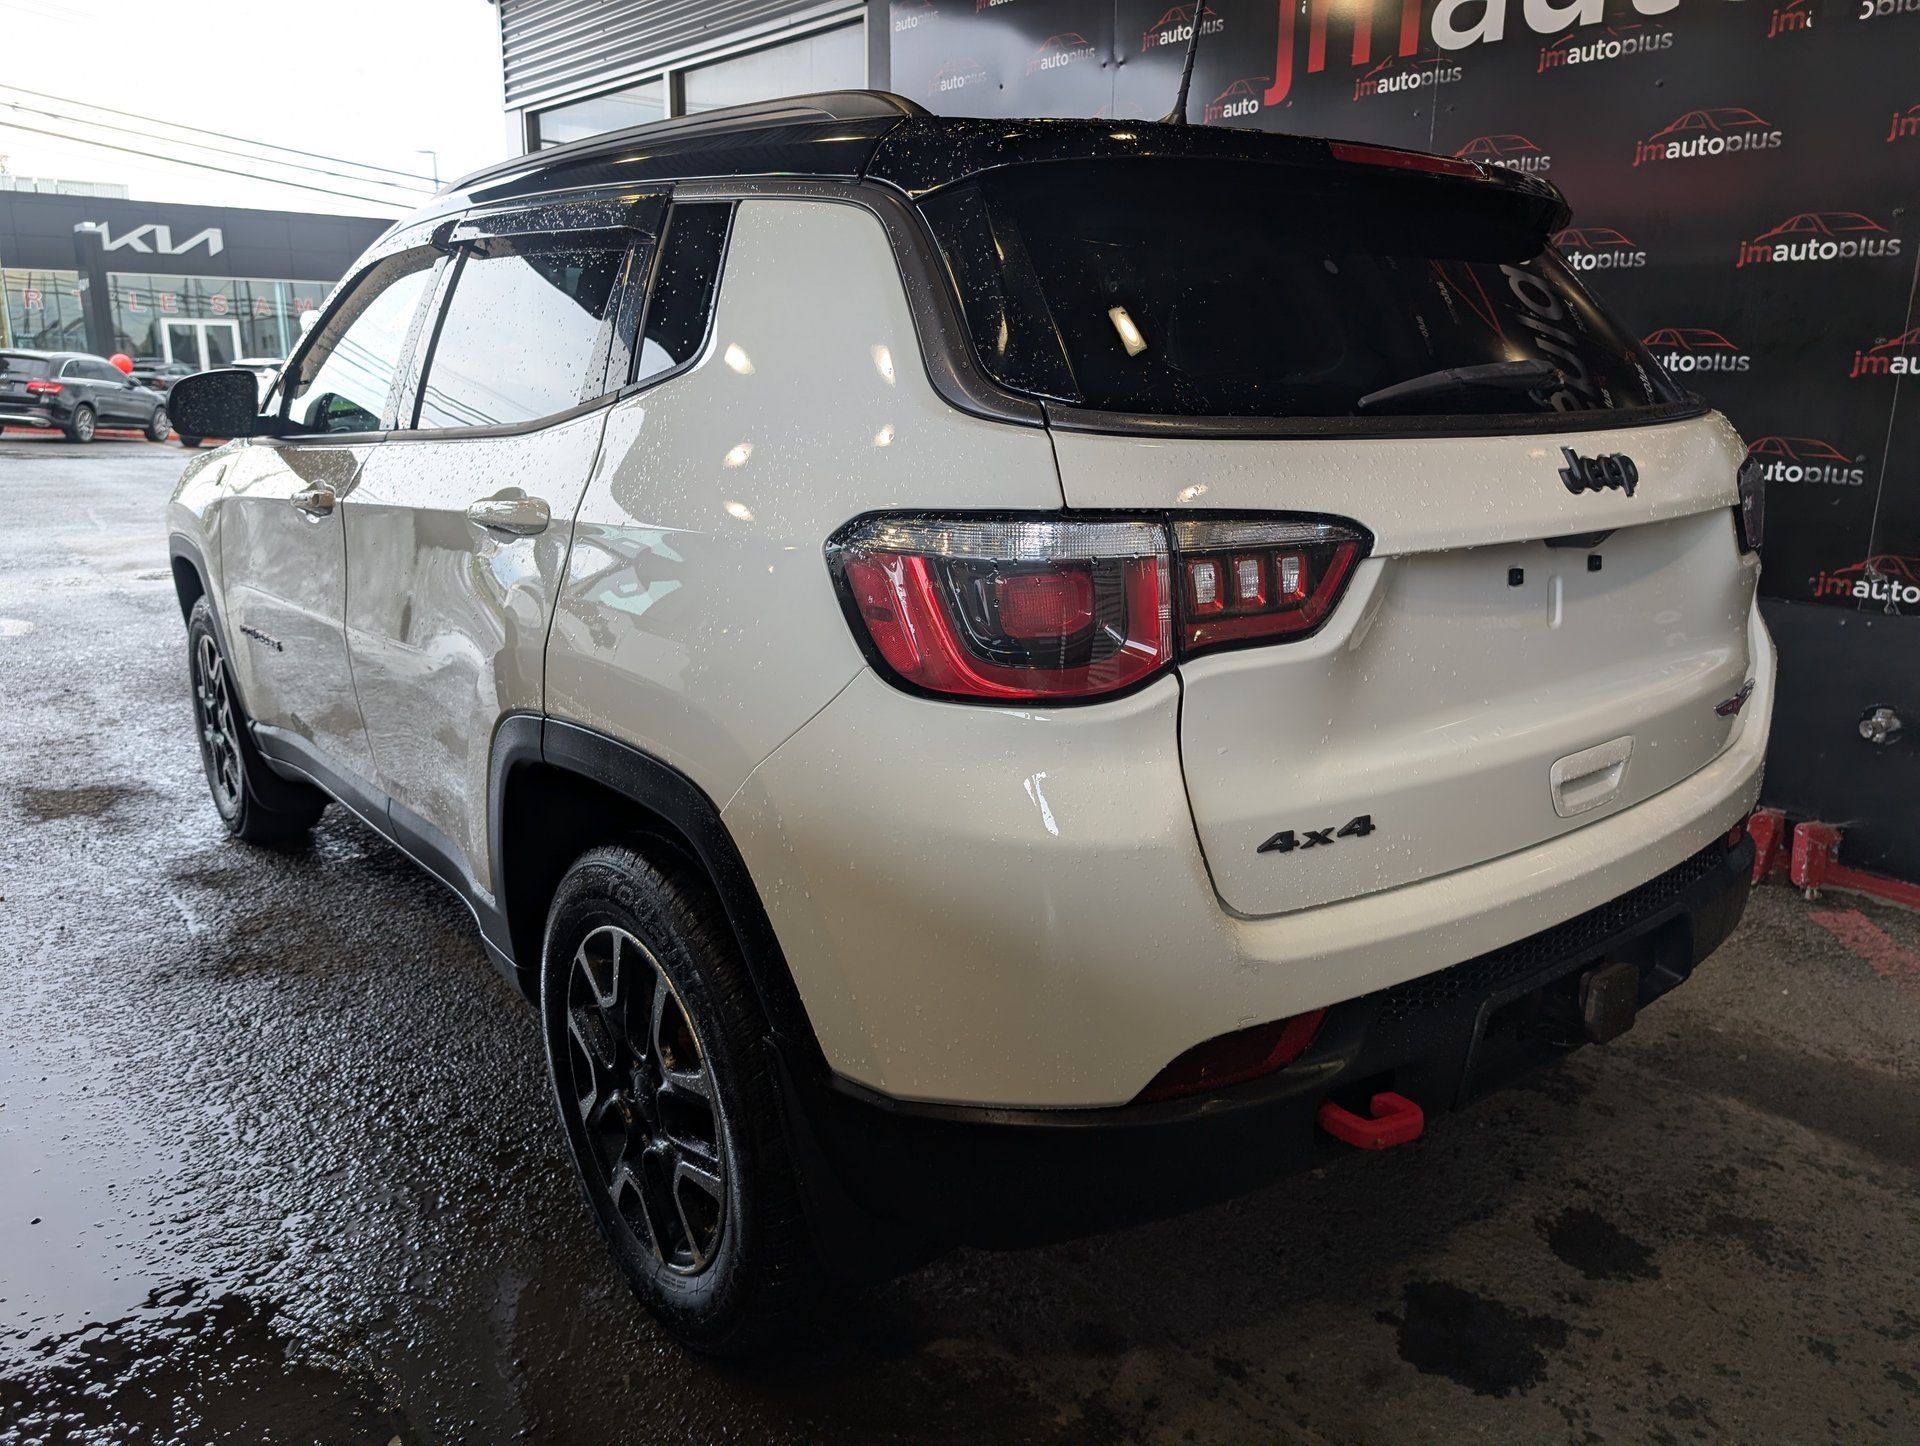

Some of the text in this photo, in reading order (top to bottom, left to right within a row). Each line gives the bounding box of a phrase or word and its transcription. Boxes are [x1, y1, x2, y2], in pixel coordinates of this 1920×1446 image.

[1141, 18, 1224, 52] jmautolus
[1537, 31, 1673, 73] jmautoplus
[1353, 65, 1462, 101] jmautoplus
[1203, 98, 1259, 125] jmauto
[1633, 129, 1782, 167] jmautoplus
[1567, 250, 1647, 271] toplus
[1736, 238, 1901, 268] jmautoplus
[1558, 446, 1640, 497] Jeep
[1257, 815, 1376, 853] 4x4
